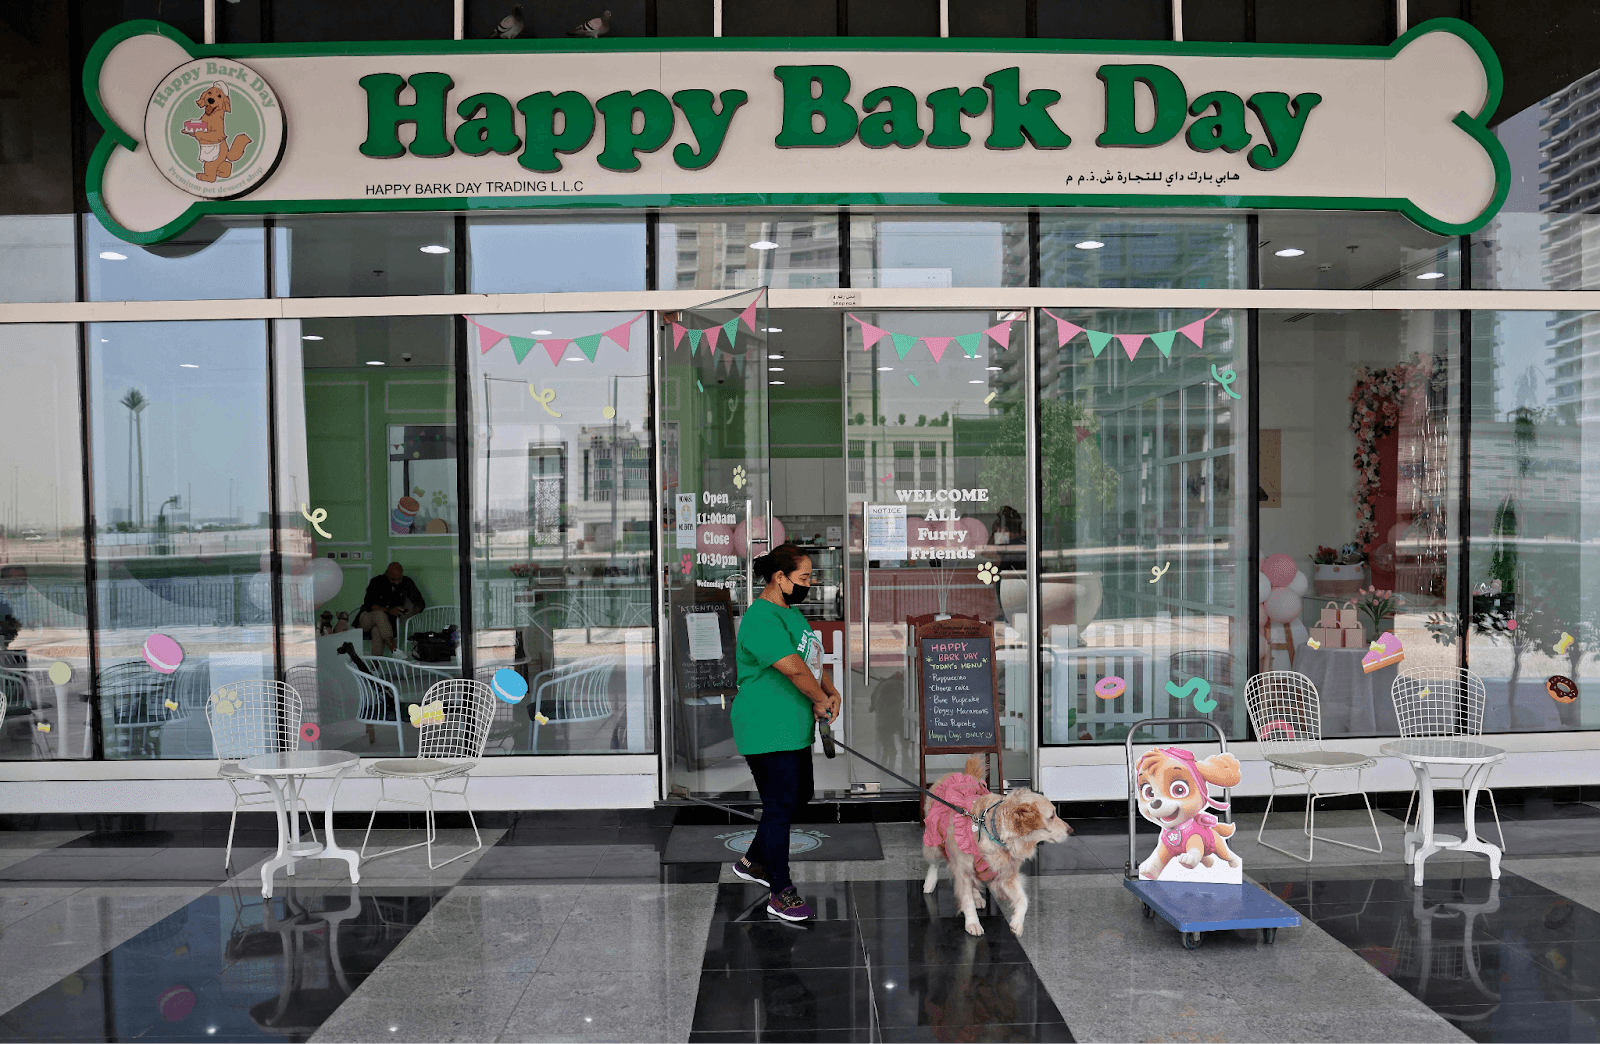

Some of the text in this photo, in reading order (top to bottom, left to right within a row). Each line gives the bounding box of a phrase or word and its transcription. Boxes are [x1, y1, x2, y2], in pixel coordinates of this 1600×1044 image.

[153, 62, 275, 109] Happy Bark Day
[359, 64, 1322, 173] Happy Bark Day
[169, 166, 263, 194] Premium pet dessert shop
[1117, 171, 1162, 184] للتجارة
[1165, 171, 1184, 187] داي
[1187, 171, 1213, 183] بارك
[1215, 171, 1240, 187] هابي
[366, 180, 584, 195] HAPPY BARK DAY TRADING L.L.C
[703, 491, 729, 507] Open
[895, 489, 989, 502] WELCOME
[696, 512, 737, 524] 11:00am
[924, 508, 960, 521] ALL
[703, 531, 730, 545] Close
[918, 528, 968, 543] Furry
[911, 547, 976, 560] Friends
[696, 553, 737, 568] 10:30pm
[696, 579, 725, 590] Wednesday
[931, 642, 968, 652] HAPPY
[938, 652, 978, 662] BARK DAY
[933, 706, 954, 716] Doggy
[929, 729, 948, 742] Happy
